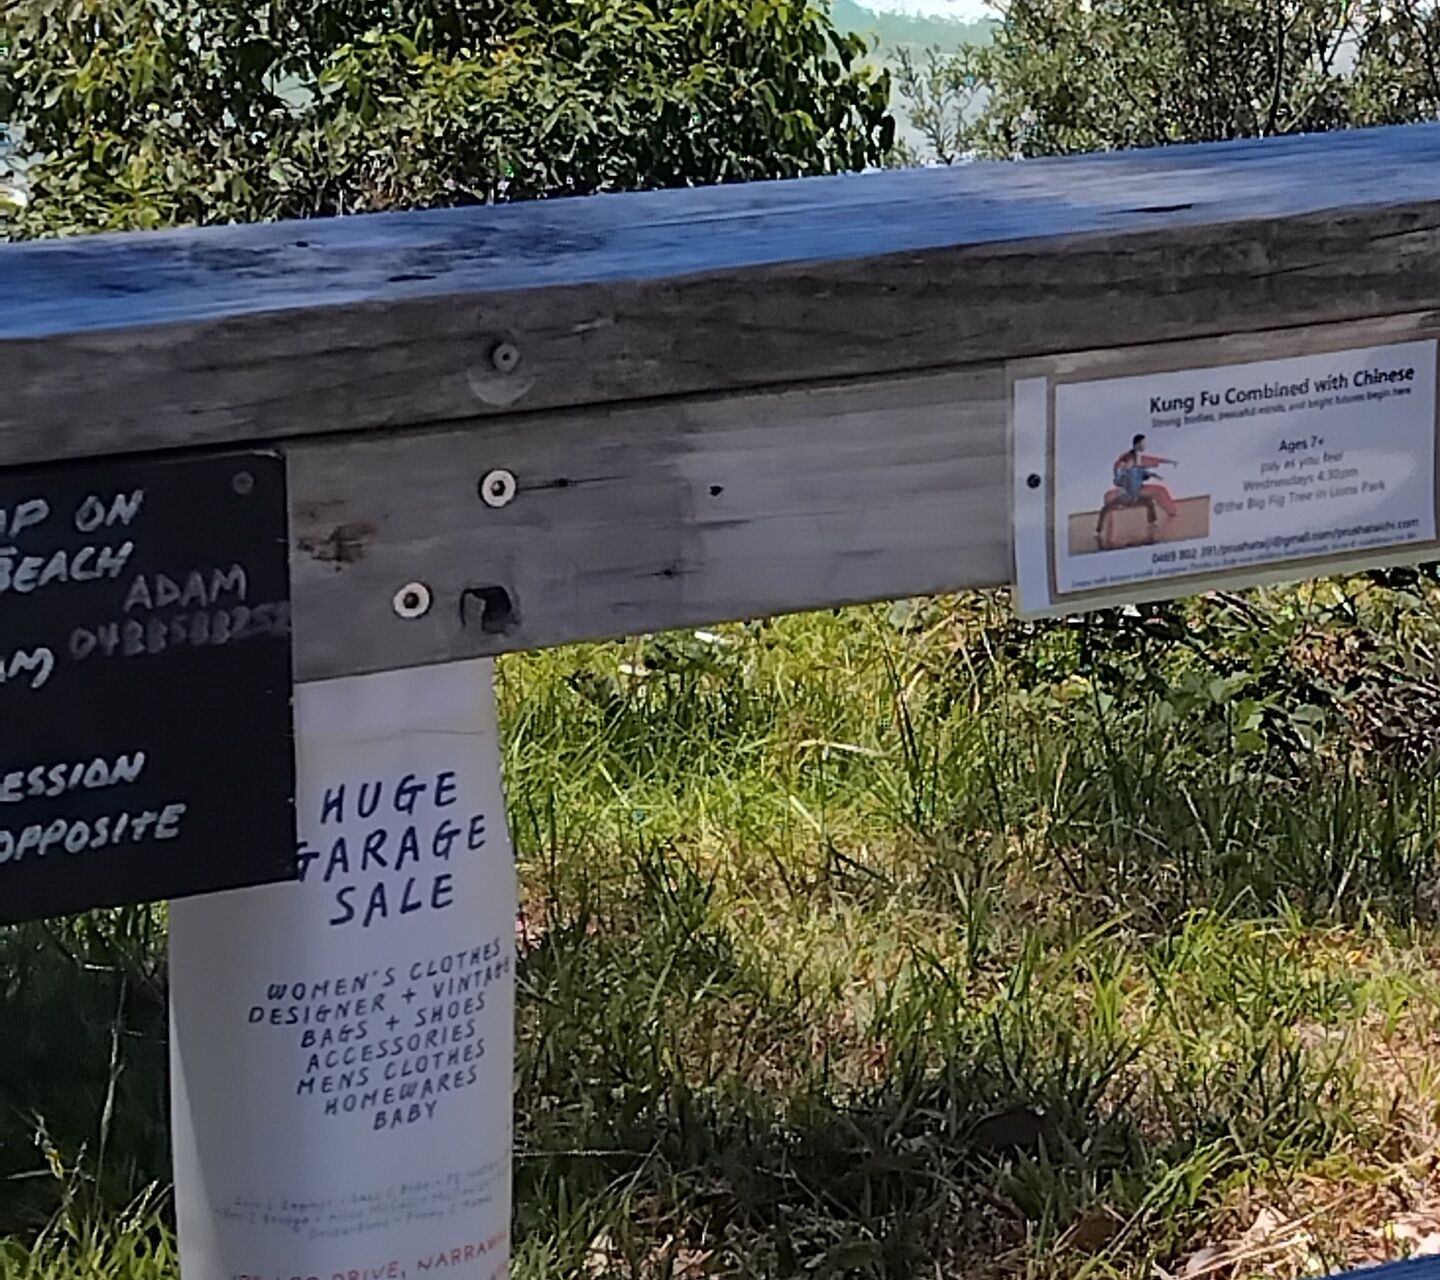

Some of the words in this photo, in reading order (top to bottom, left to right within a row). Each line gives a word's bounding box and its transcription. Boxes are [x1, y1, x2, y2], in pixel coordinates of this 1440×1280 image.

[1150, 394, 1195, 415] Kung
[1200, 391, 1220, 407] Fu
[1225, 378, 1310, 405] Combined
[1314, 374, 1349, 394] with
[1353, 365, 1415, 388] Chinese
[1278, 439, 1308, 453] Ages
[1243, 474, 1314, 492] Wednesdays
[75, 489, 144, 533] ON
[123, 563, 248, 612] ADAM
[319, 771, 458, 825] HUGE
[329, 873, 454, 928] SALE
[266, 966, 397, 1001] WOMEN'S
[409, 936, 502, 982] CLOTHES
[247, 992, 387, 1025] DESIGNER
[400, 986, 418, 1005] +
[300, 1019, 368, 1049] BAGS
[385, 1015, 400, 1032] +
[414, 991, 486, 1028] SHOES
[296, 1066, 370, 1096] MENS
[383, 1037, 486, 1082] CLOTHES
[306, 1018, 476, 1074] ACCESSORIES
[323, 1064, 478, 1116] HOMEWARES
[372, 1099, 438, 1131] BABY
